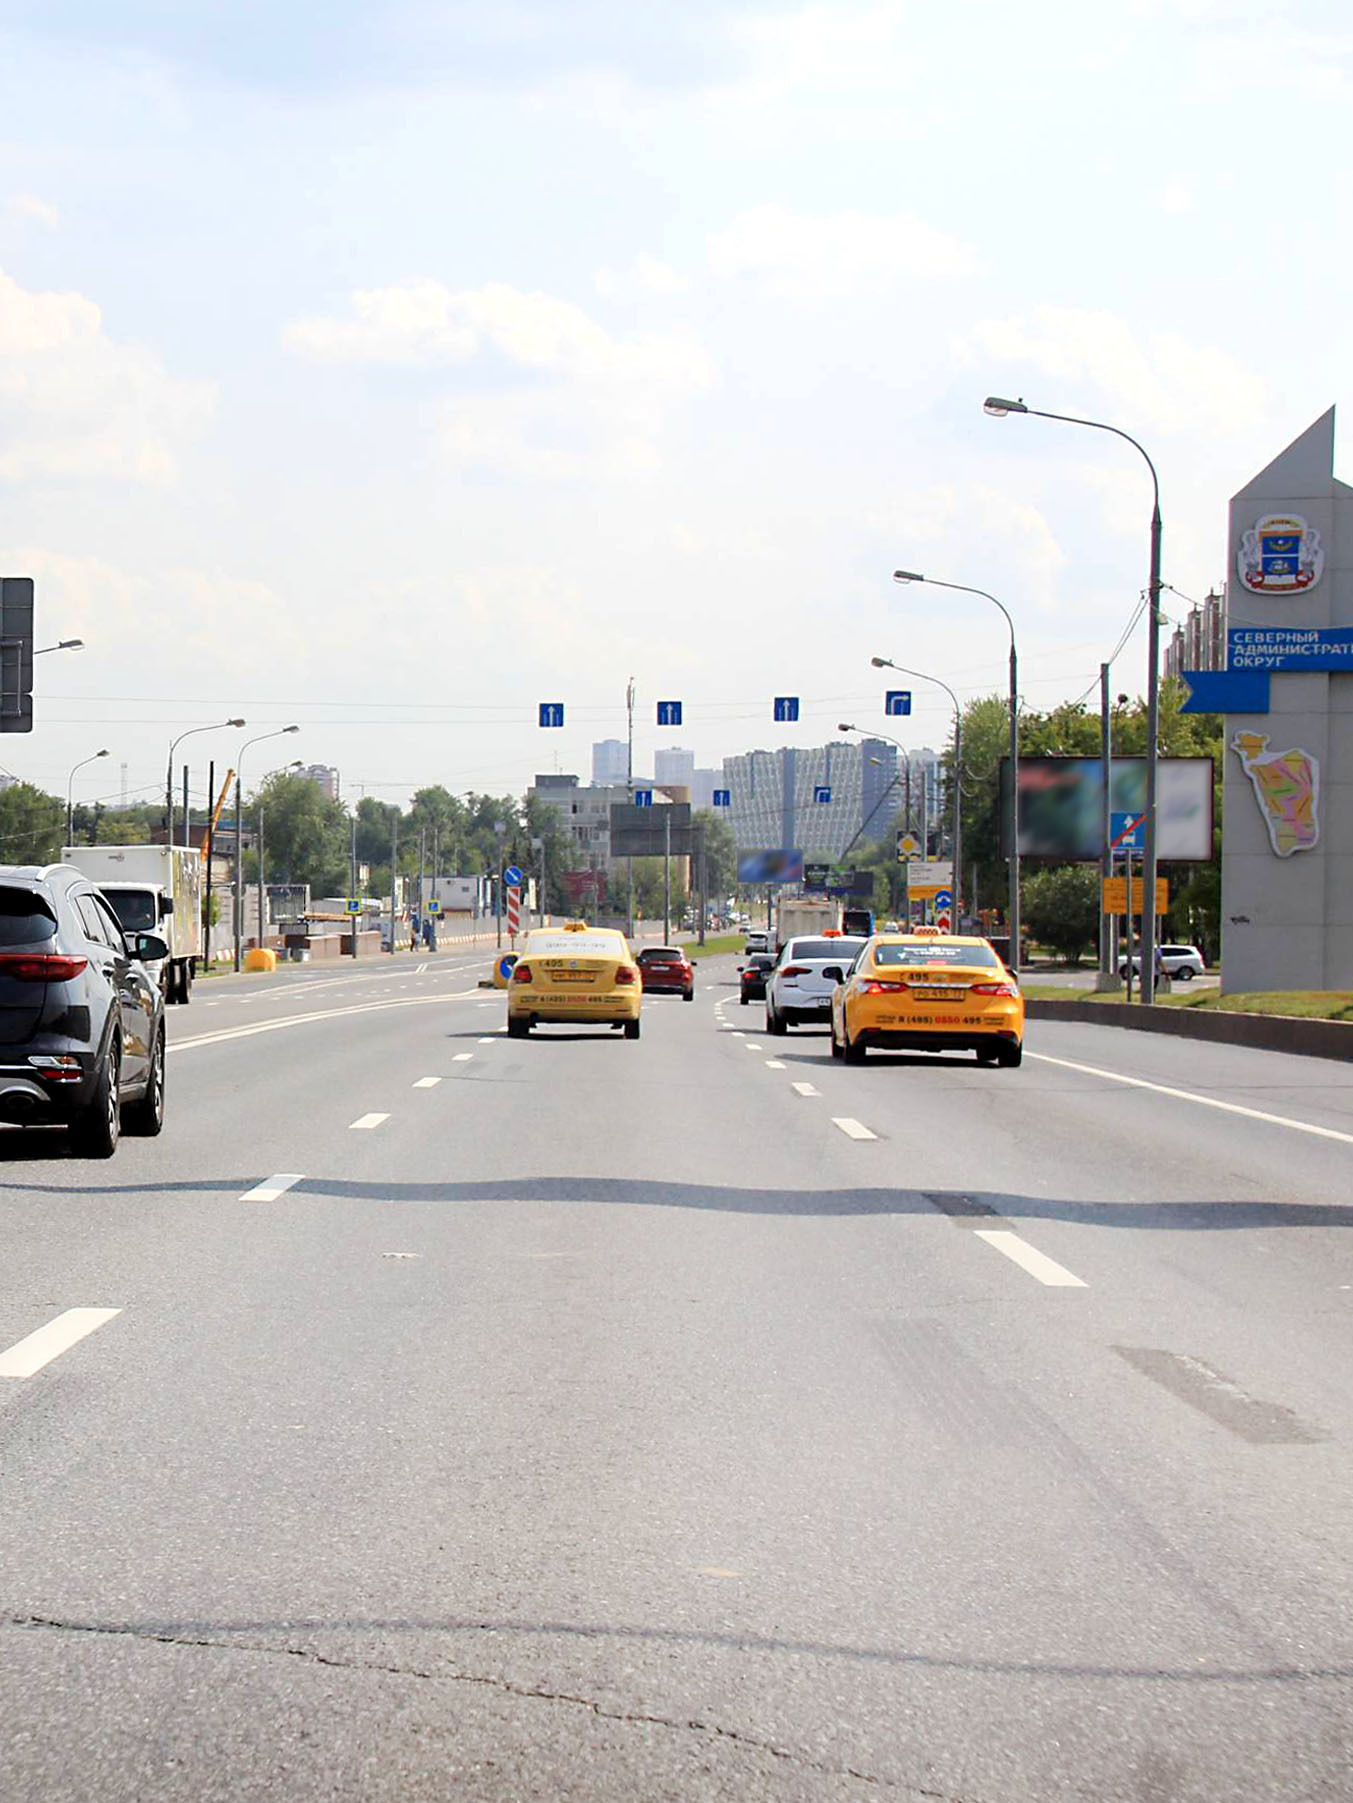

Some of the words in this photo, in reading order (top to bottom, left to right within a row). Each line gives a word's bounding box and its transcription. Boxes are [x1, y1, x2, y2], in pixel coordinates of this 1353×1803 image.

[1233, 631, 1320, 643] СЕВЕРНЫЙ
[1234, 644, 1353, 656] АДМИНИСТРАТ
[1233, 656, 1286, 667] ОКРУГ
